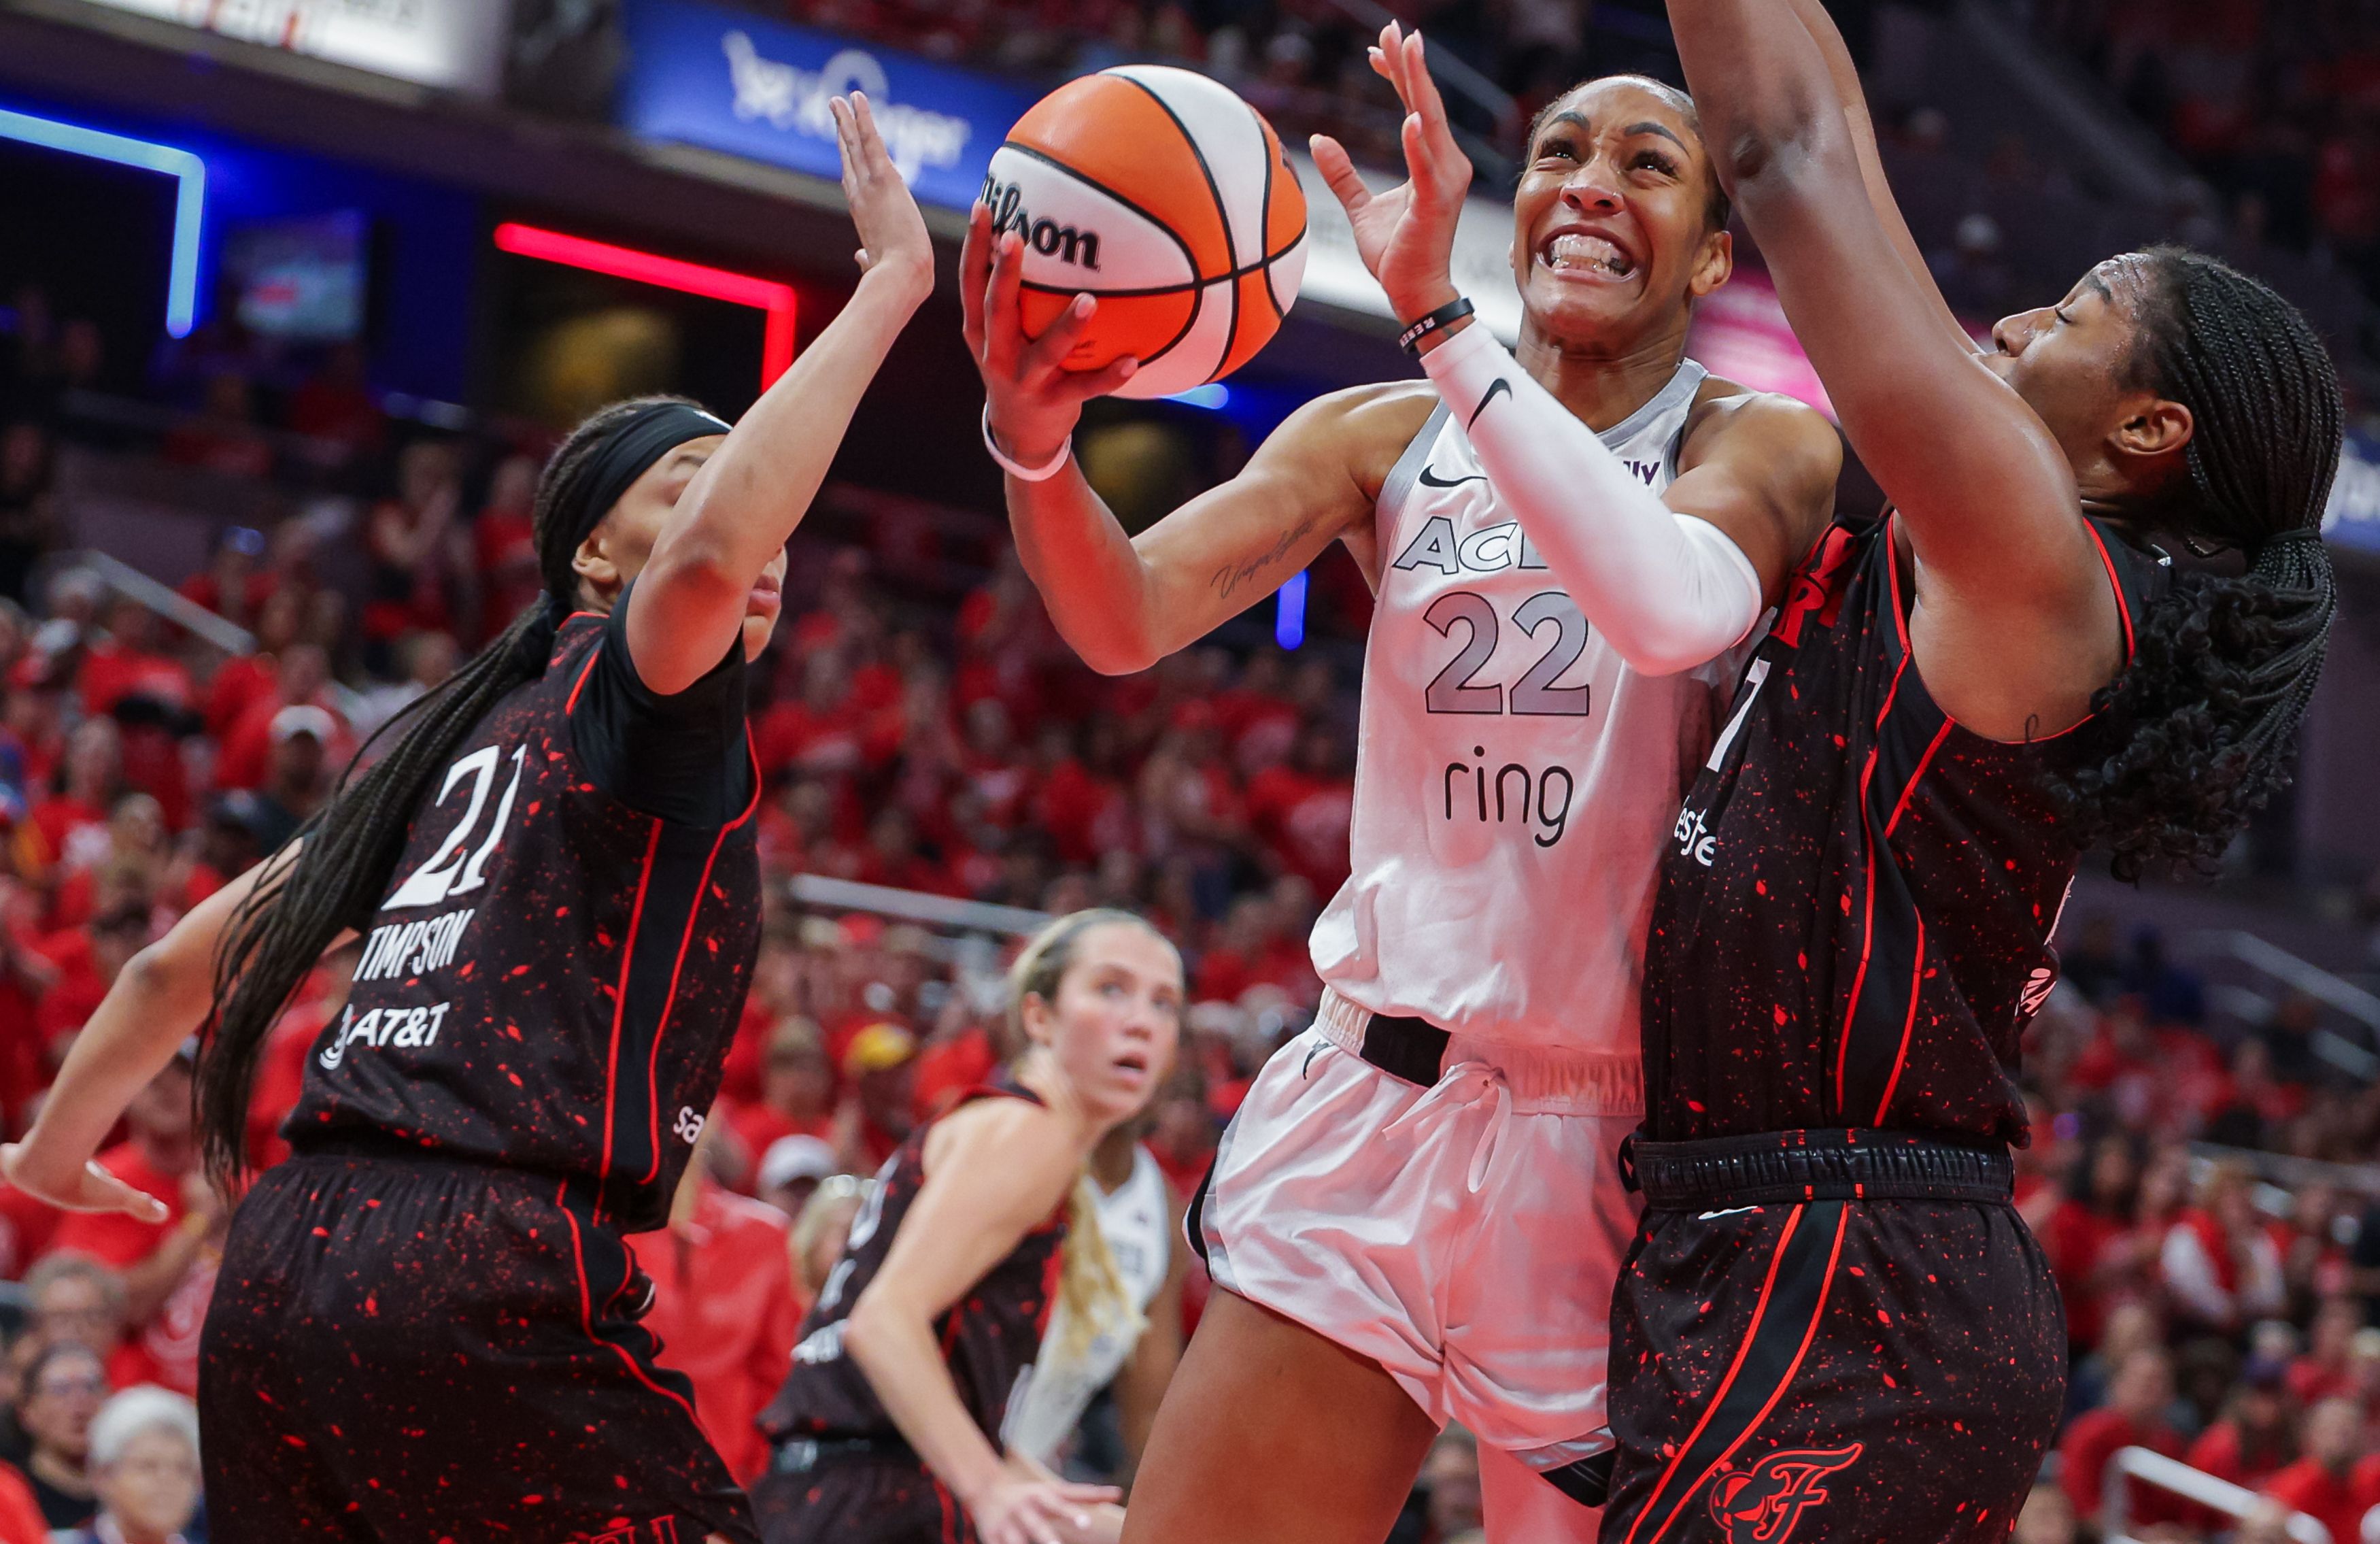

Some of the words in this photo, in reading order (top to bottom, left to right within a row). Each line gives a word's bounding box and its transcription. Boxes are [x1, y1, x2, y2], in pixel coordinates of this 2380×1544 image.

[1423, 590, 1590, 716] 22
[380, 743, 526, 912] 21
[1444, 745, 1574, 848] ring
[352, 908, 475, 983] TIMPSON
[345, 1002, 450, 1048] AT&T
